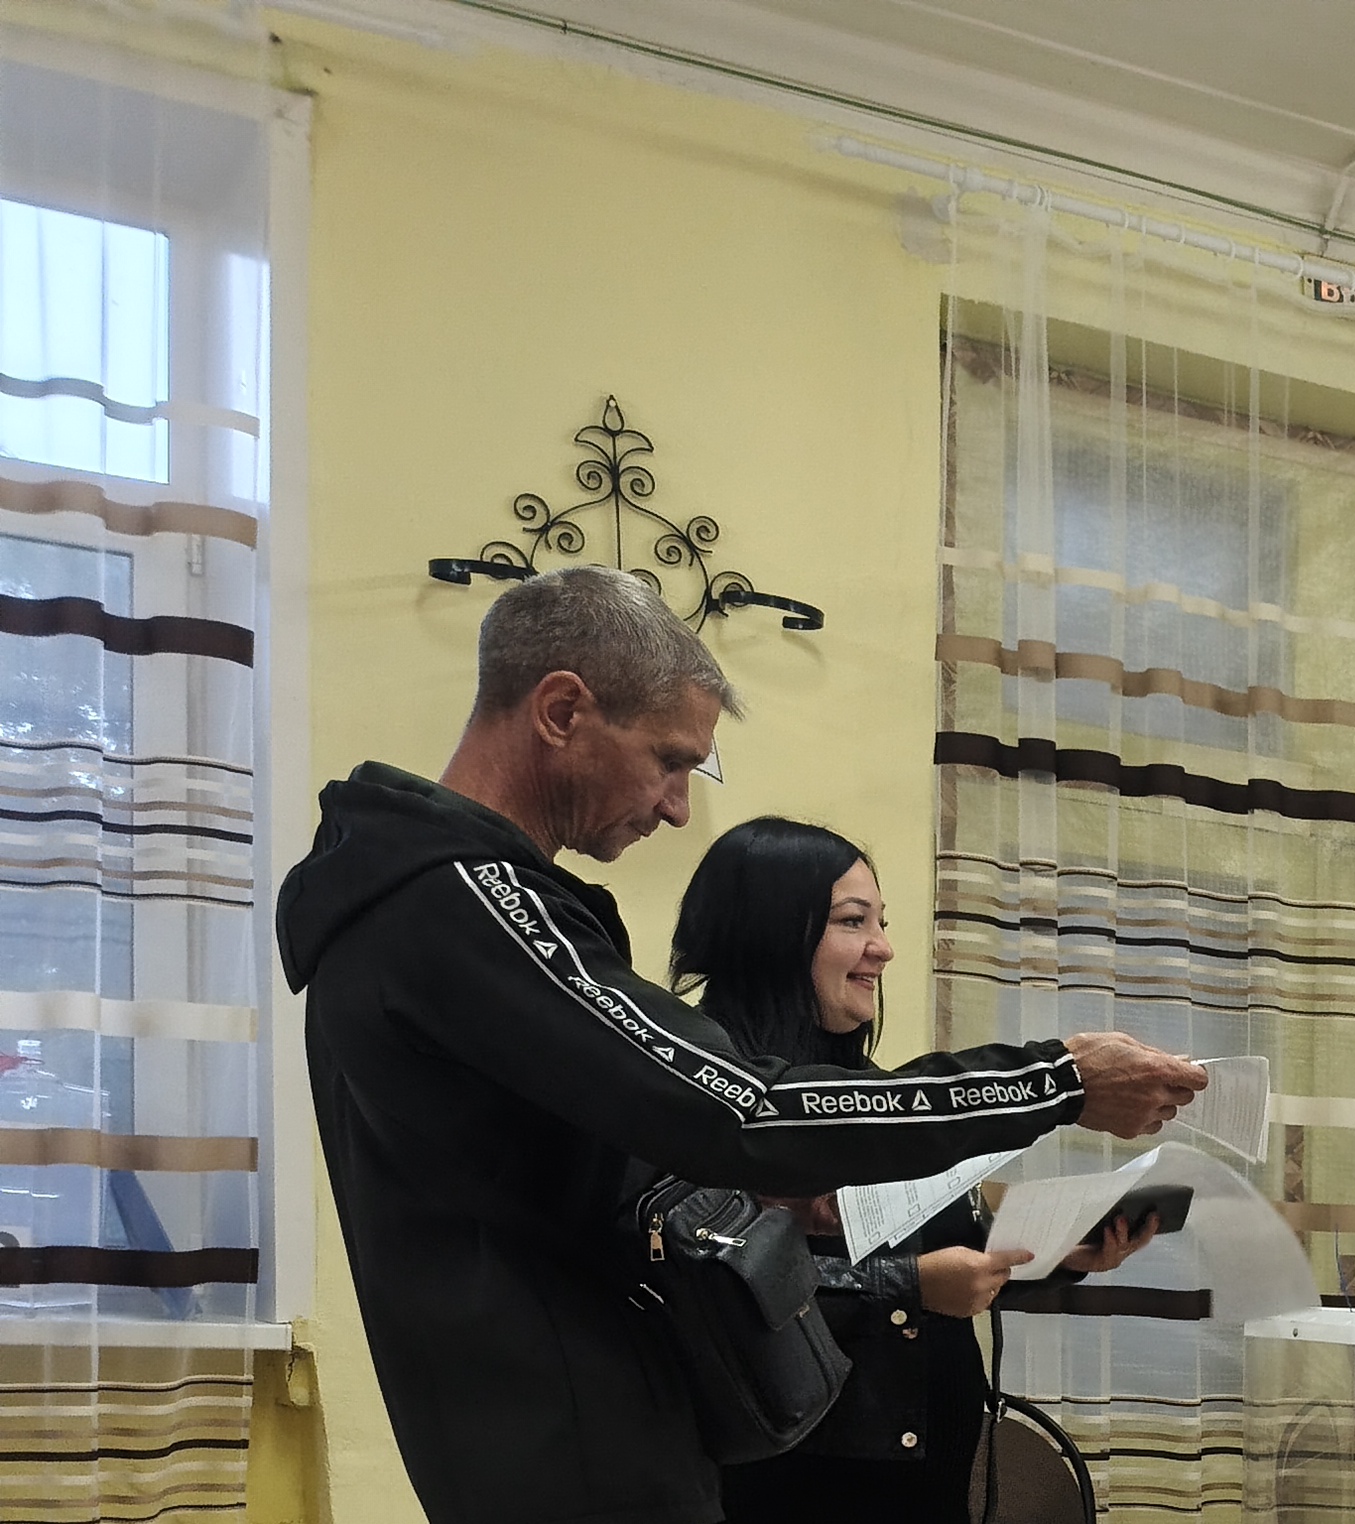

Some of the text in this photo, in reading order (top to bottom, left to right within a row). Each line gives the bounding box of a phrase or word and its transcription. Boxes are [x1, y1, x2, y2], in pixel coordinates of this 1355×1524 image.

[473, 862, 1038, 1116] Reebok Reebok Reeb Reebok Reebok
